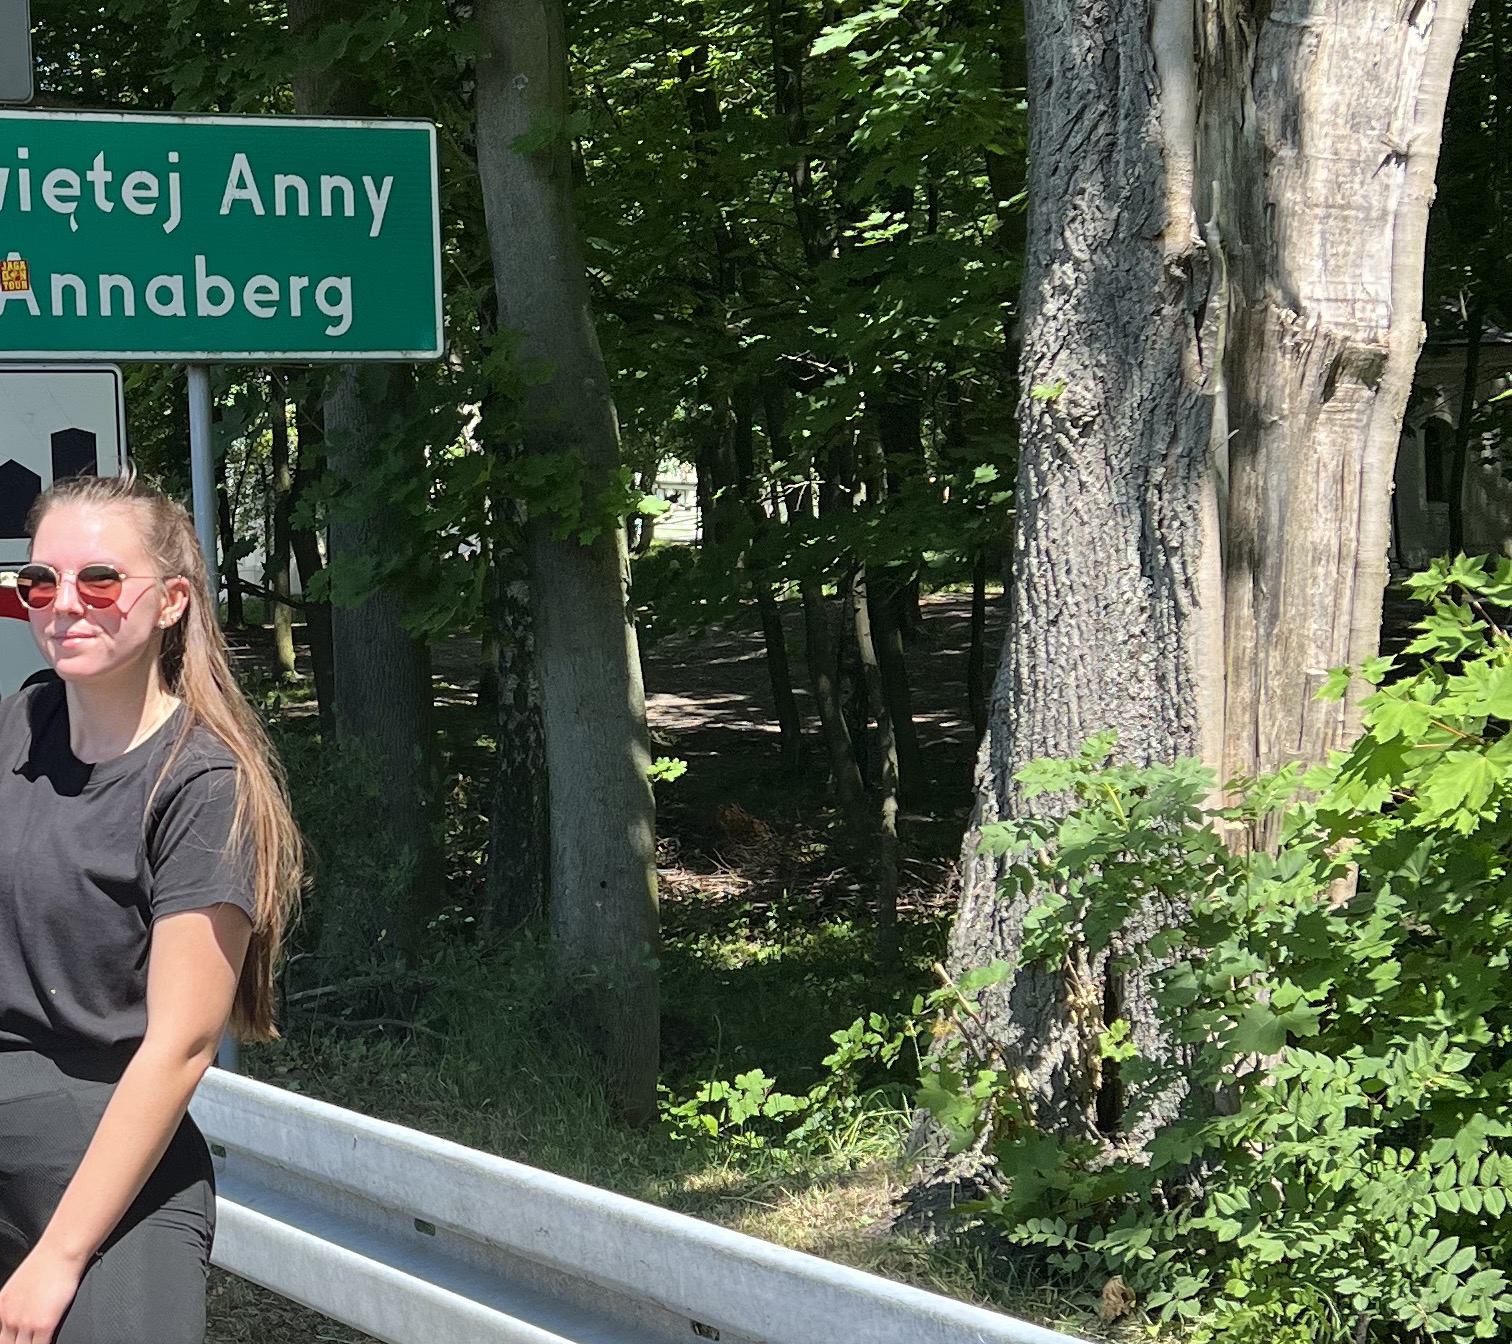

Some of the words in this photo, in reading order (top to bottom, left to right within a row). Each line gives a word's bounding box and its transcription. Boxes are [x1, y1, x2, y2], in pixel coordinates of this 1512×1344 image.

[219, 152, 395, 237] Anny
[1, 261, 27, 271] JAGA
[2, 281, 28, 291] TOUR
